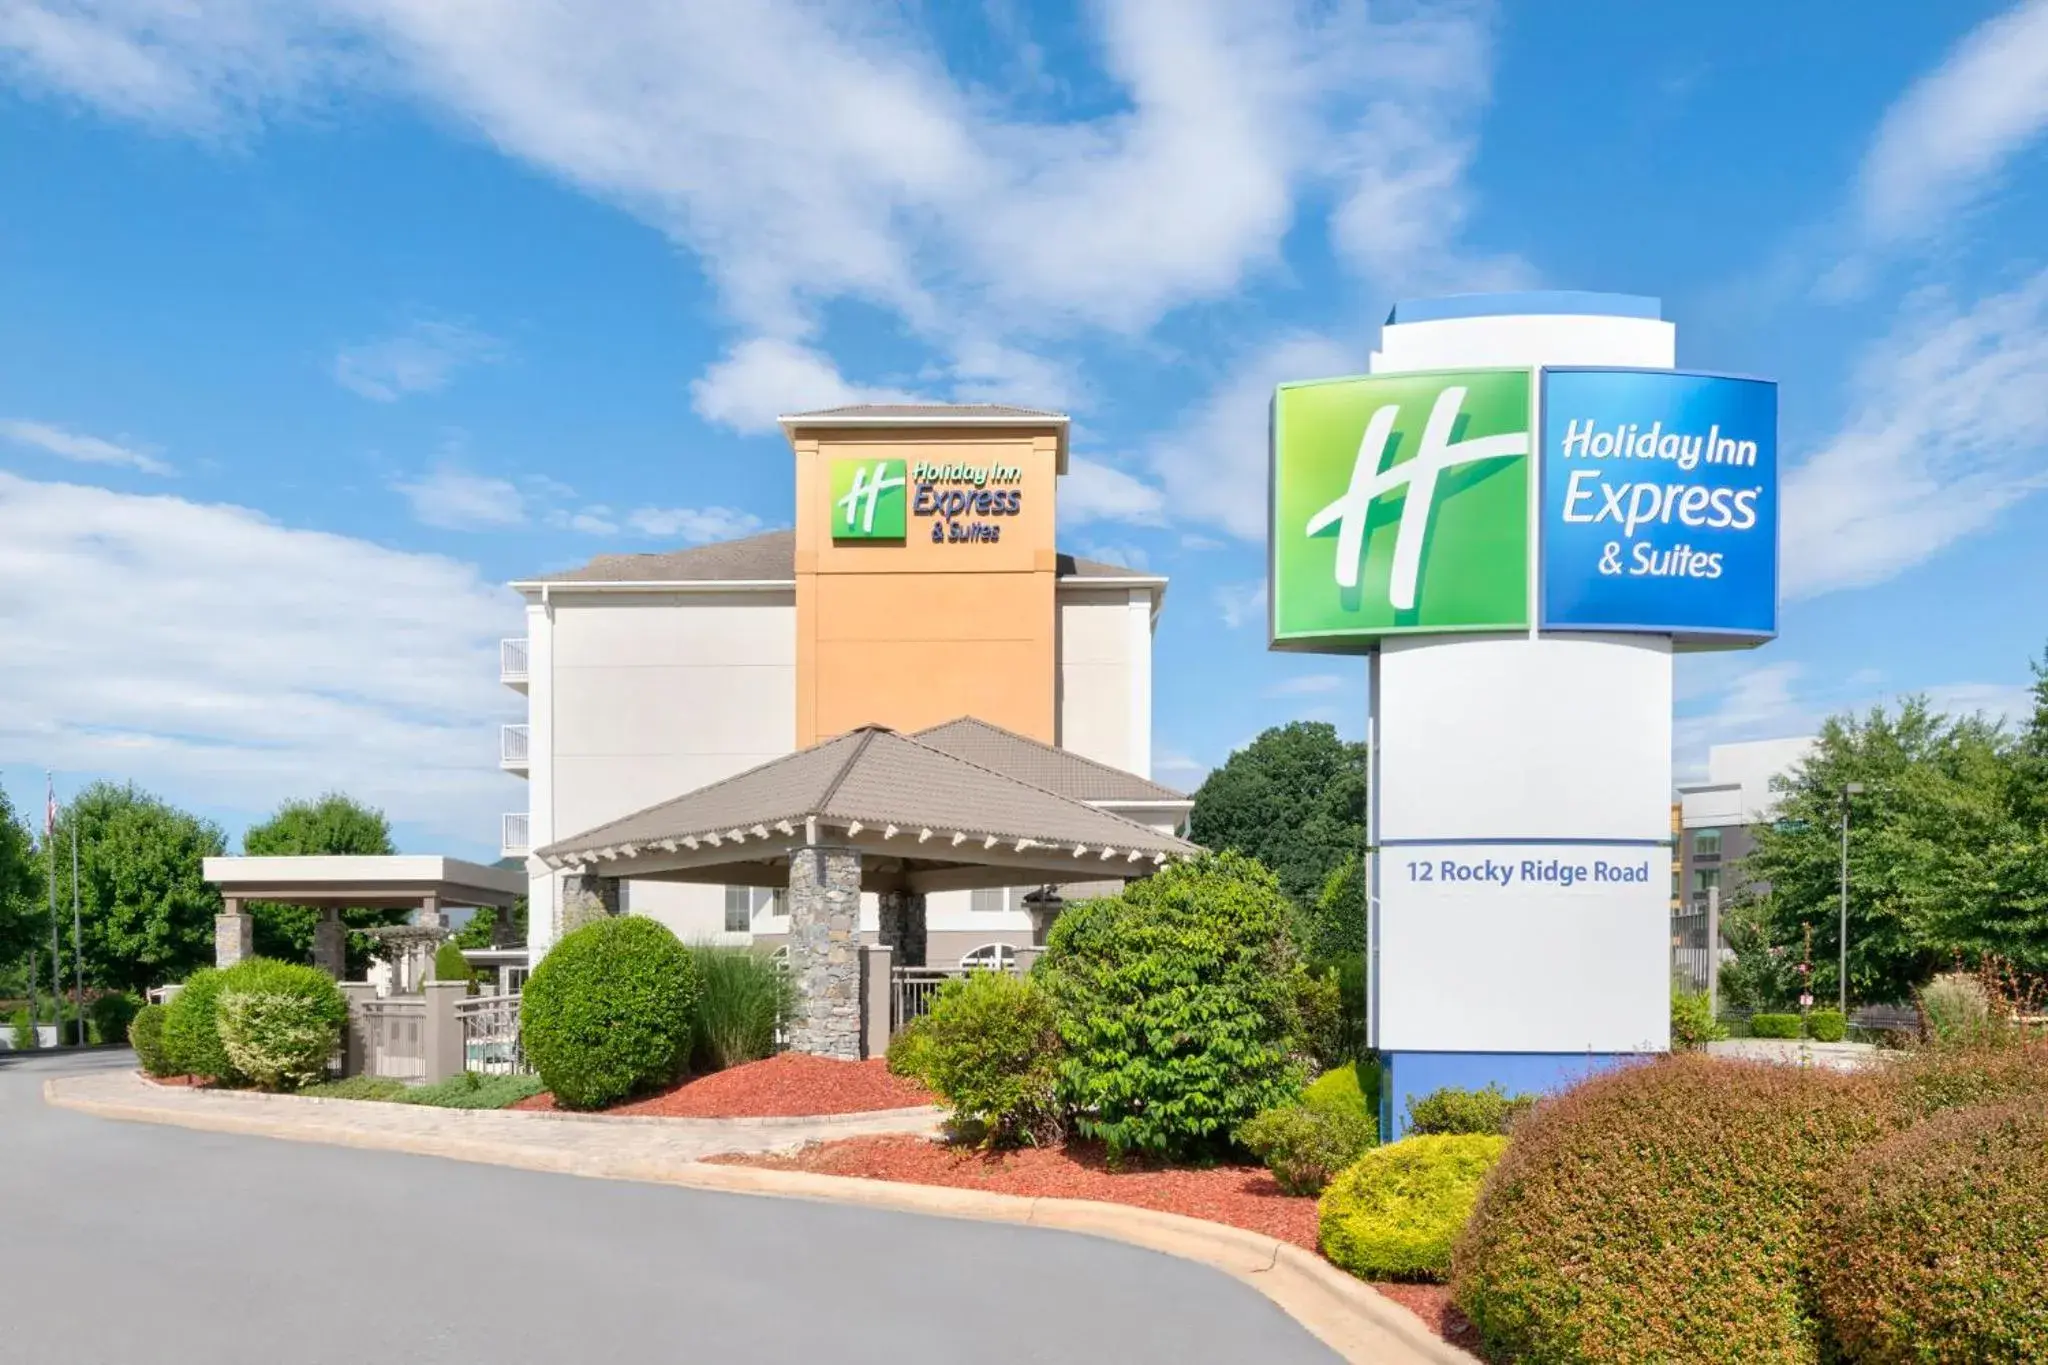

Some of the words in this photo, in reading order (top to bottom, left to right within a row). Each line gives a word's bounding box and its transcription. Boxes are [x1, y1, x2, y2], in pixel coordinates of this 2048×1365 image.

[1562, 419, 1702, 470] Holiday
[1706, 424, 1757, 467] Inn
[912, 461, 988, 485] Holiday
[989, 463, 1021, 482] Inn
[913, 483, 1021, 523] Express
[1563, 470, 1758, 537] Express
[932, 522, 944, 543] &
[949, 522, 1001, 543] Suites
[1598, 542, 1623, 576] &
[1629, 541, 1724, 579] Suites
[1407, 861, 1433, 882] 12
[1441, 860, 1514, 886] Rocky
[1521, 860, 1588, 886] Ridge
[1594, 861, 1649, 882] Road
